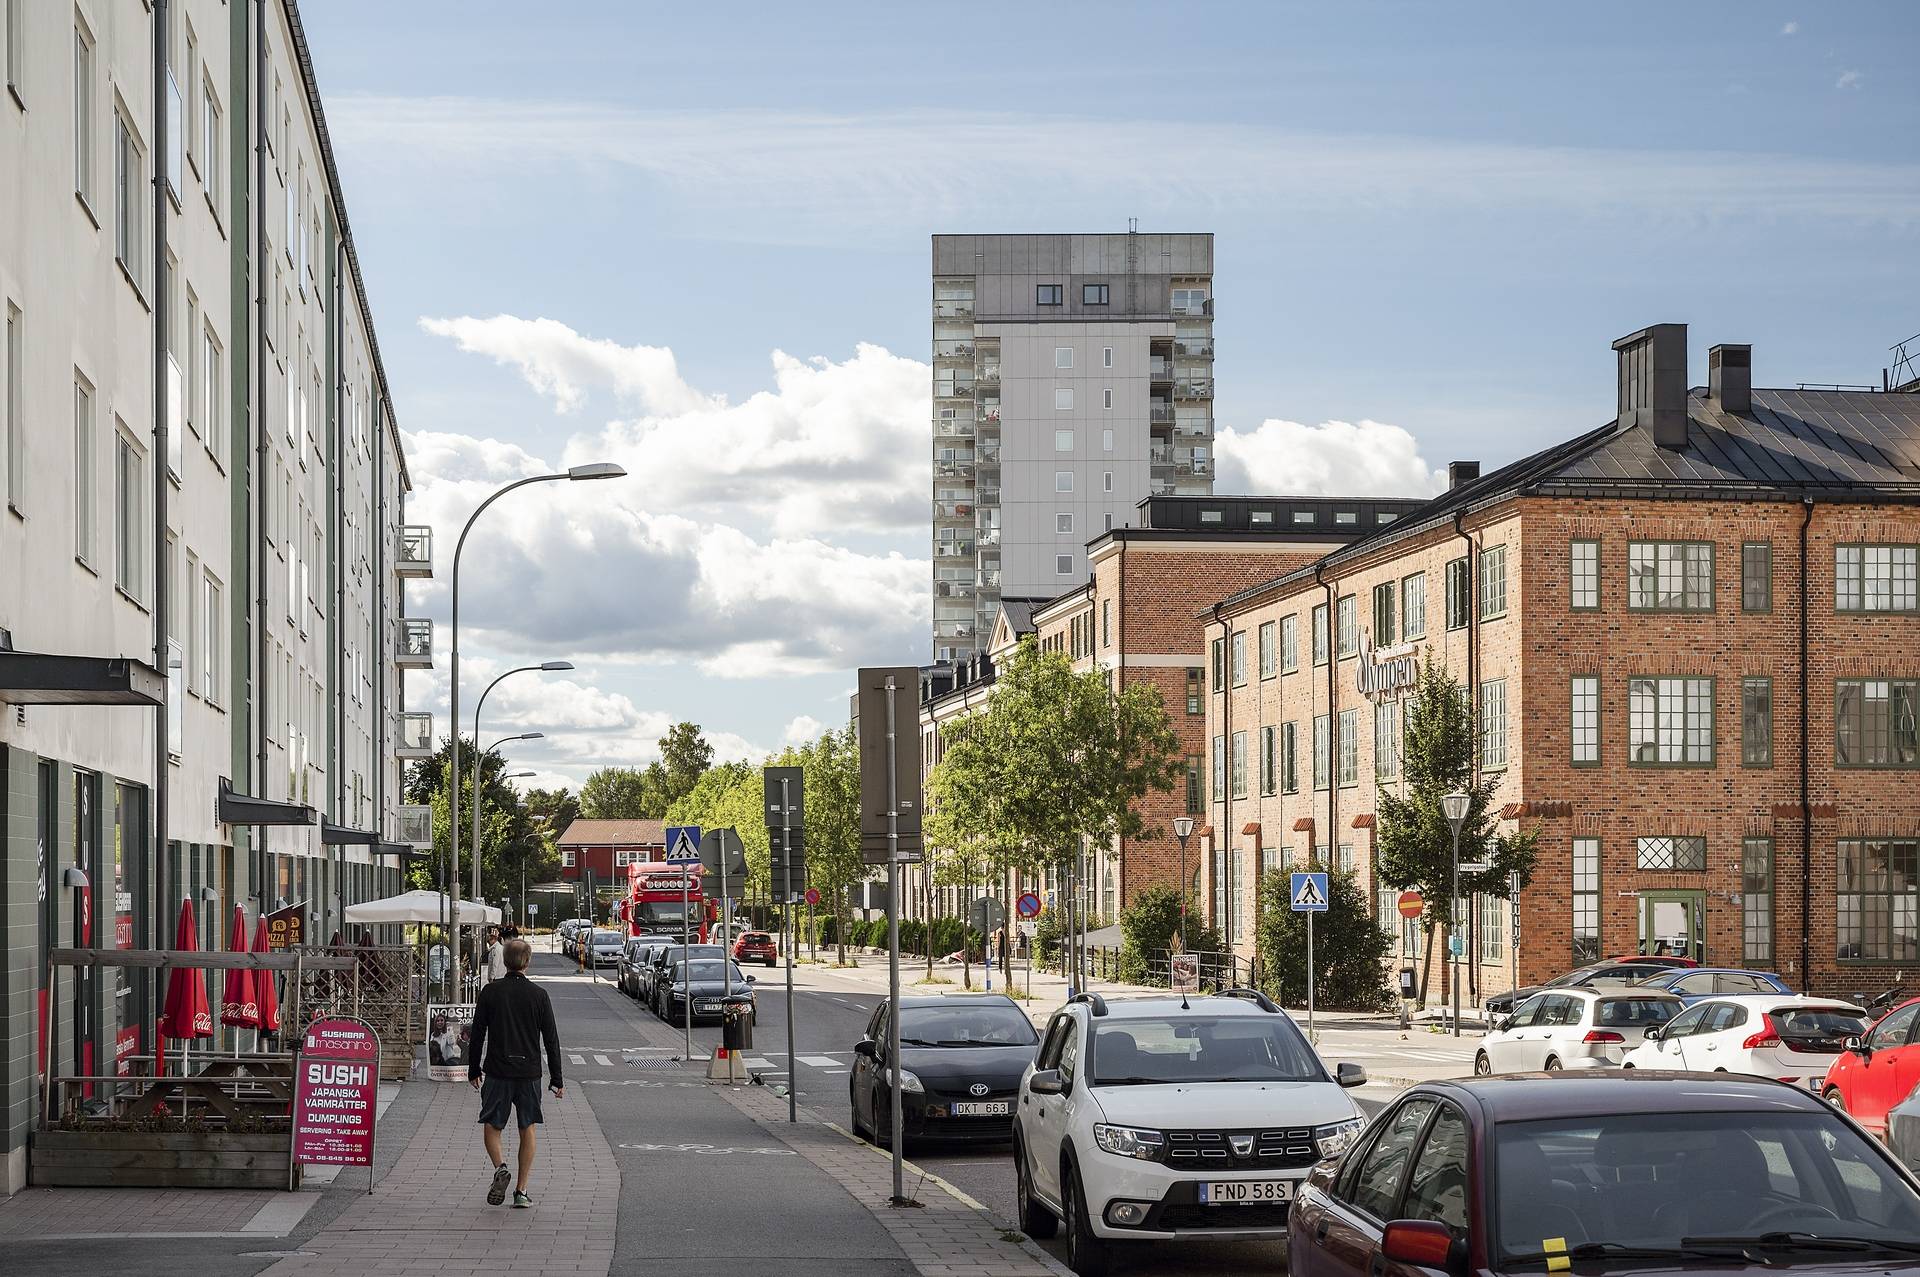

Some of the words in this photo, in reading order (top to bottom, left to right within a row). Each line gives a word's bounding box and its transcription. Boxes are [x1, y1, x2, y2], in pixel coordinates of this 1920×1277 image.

[321, 1030, 365, 1039] SUSHIBAR
[308, 1064, 368, 1086] SUSHI
[311, 1088, 361, 1098] JAPANSKA
[305, 1098, 367, 1110] VARMRÄTTER
[957, 1103, 978, 1113] DKT
[985, 1103, 1006, 1113] 663
[308, 1113, 362, 1124] DUMPLINGS
[299, 1126, 332, 1135] SERVERING
[1214, 1184, 1247, 1200] FND
[1253, 1183, 1286, 1199] 58S
